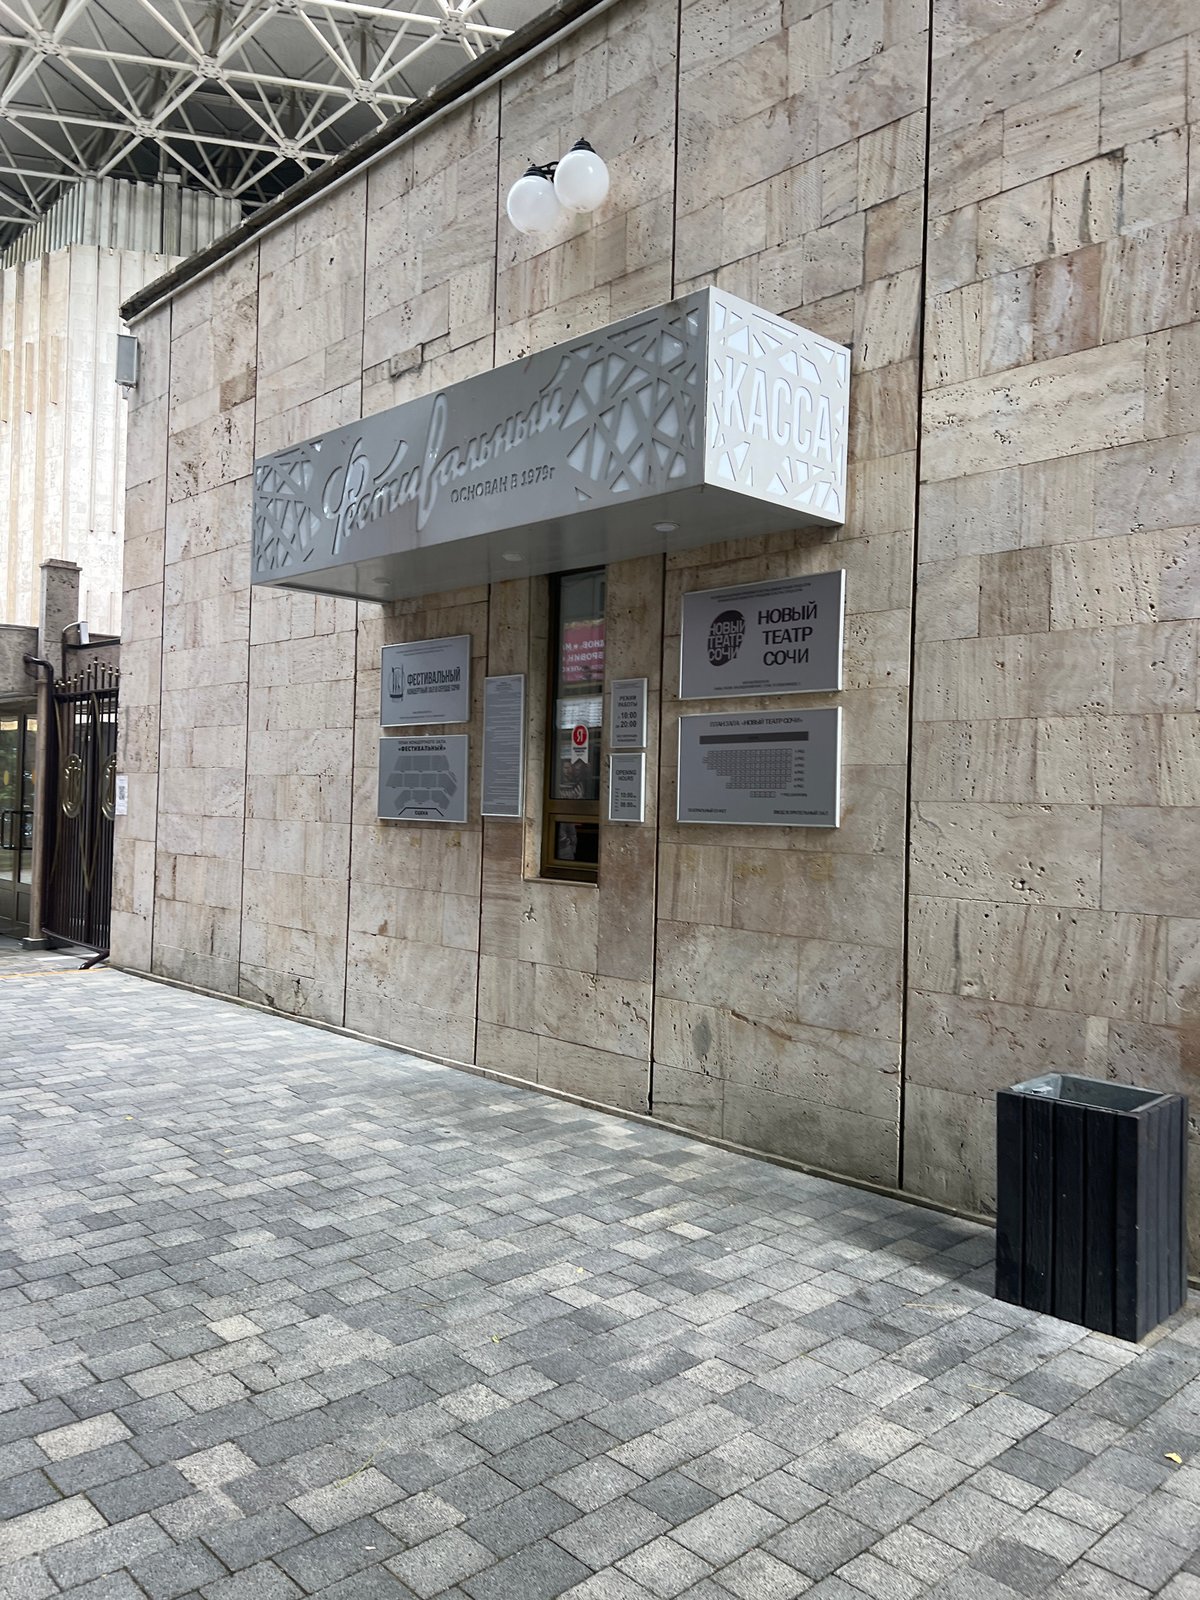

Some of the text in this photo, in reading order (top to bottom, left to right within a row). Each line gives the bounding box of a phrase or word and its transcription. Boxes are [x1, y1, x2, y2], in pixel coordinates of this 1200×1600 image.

[724, 355, 833, 463] КАССА
[322, 355, 571, 555] Фестивальный
[449, 475, 508, 503] ОСНОВАН
[510, 473, 519, 490] В
[758, 600, 818, 625] НОВЫЙ
[762, 626, 813, 645] ТЕАТР
[763, 648, 809, 666] СОЧИ
[407, 666, 461, 687] ФЕСТИВАЛЬНЫЙ
[620, 720, 637, 728] 20:00
